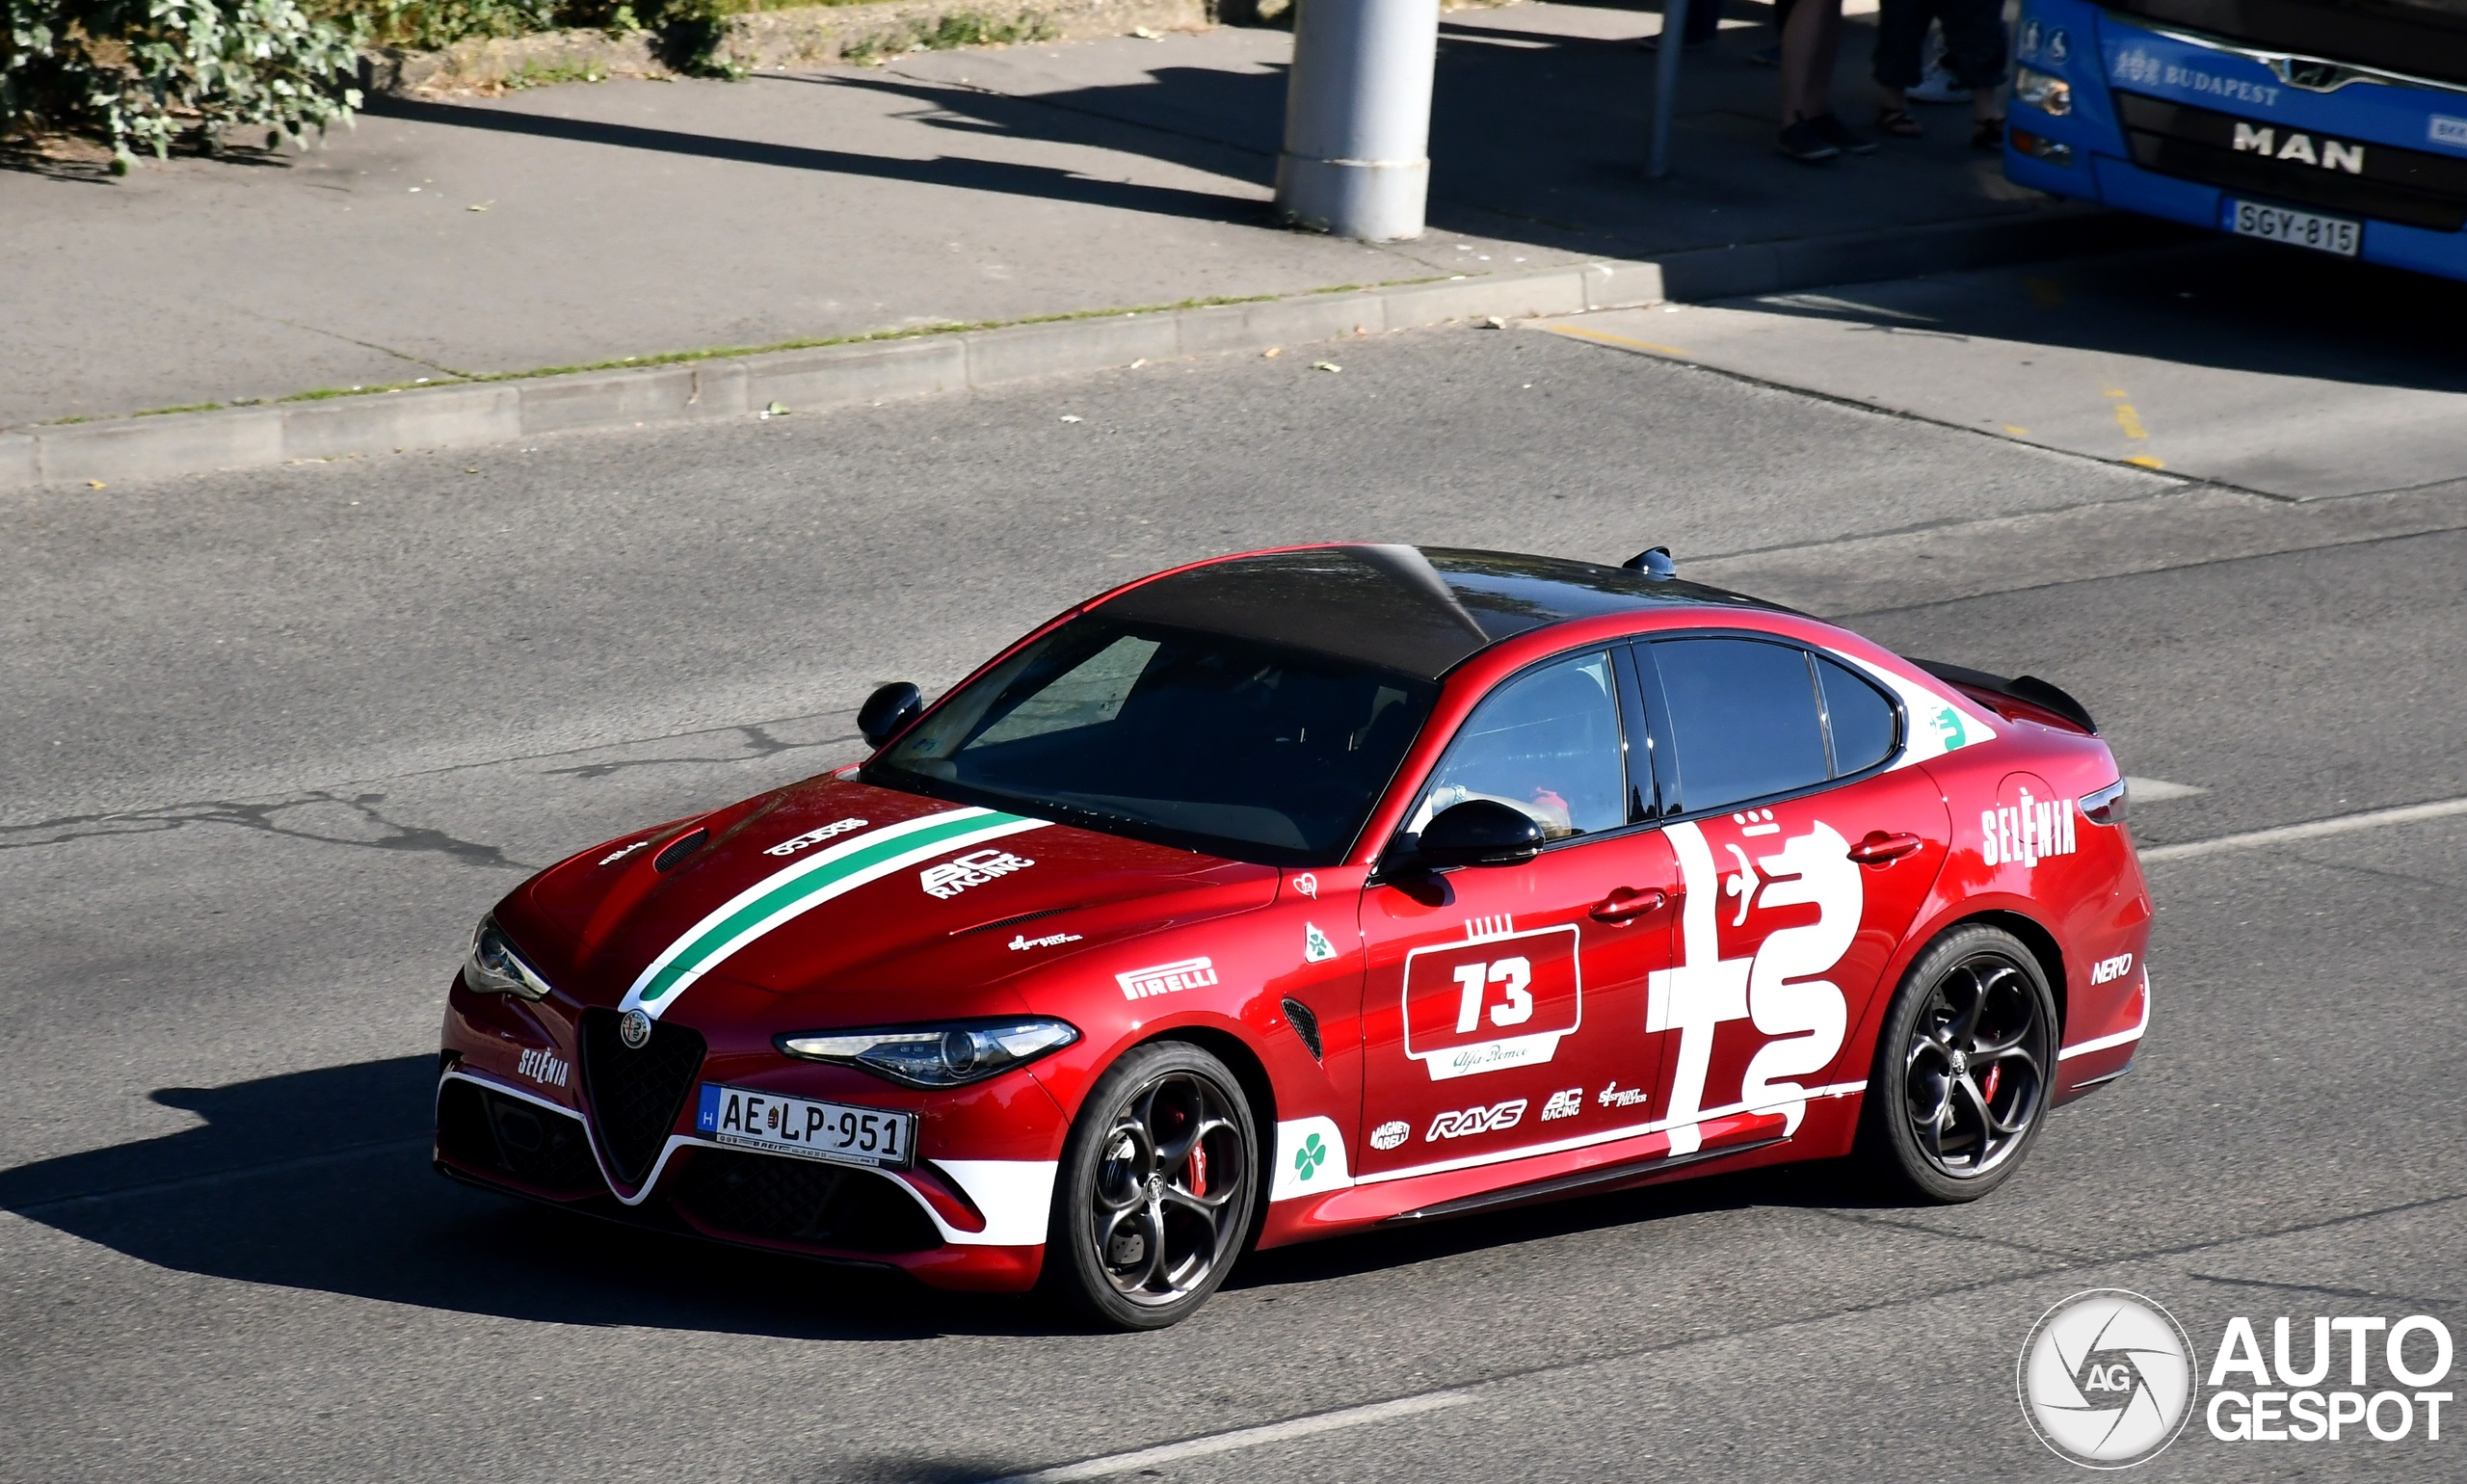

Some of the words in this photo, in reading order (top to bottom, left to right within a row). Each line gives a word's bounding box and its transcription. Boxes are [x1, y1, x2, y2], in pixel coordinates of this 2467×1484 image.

[2165, 66, 2280, 106] BUDAPEST
[2233, 122, 2365, 174] MAN
[2239, 205, 2353, 252] SGY-815
[920, 849, 1015, 892] BC
[926, 857, 1036, 900] RACING
[1114, 956, 1219, 1001] PIRELLI
[1452, 956, 1534, 1034] 73
[1541, 1103, 1580, 1122] RACING
[1544, 1087, 1583, 1109] BC
[1615, 1093, 1648, 1107] FILTER
[1425, 1099, 1528, 1143] RAYS
